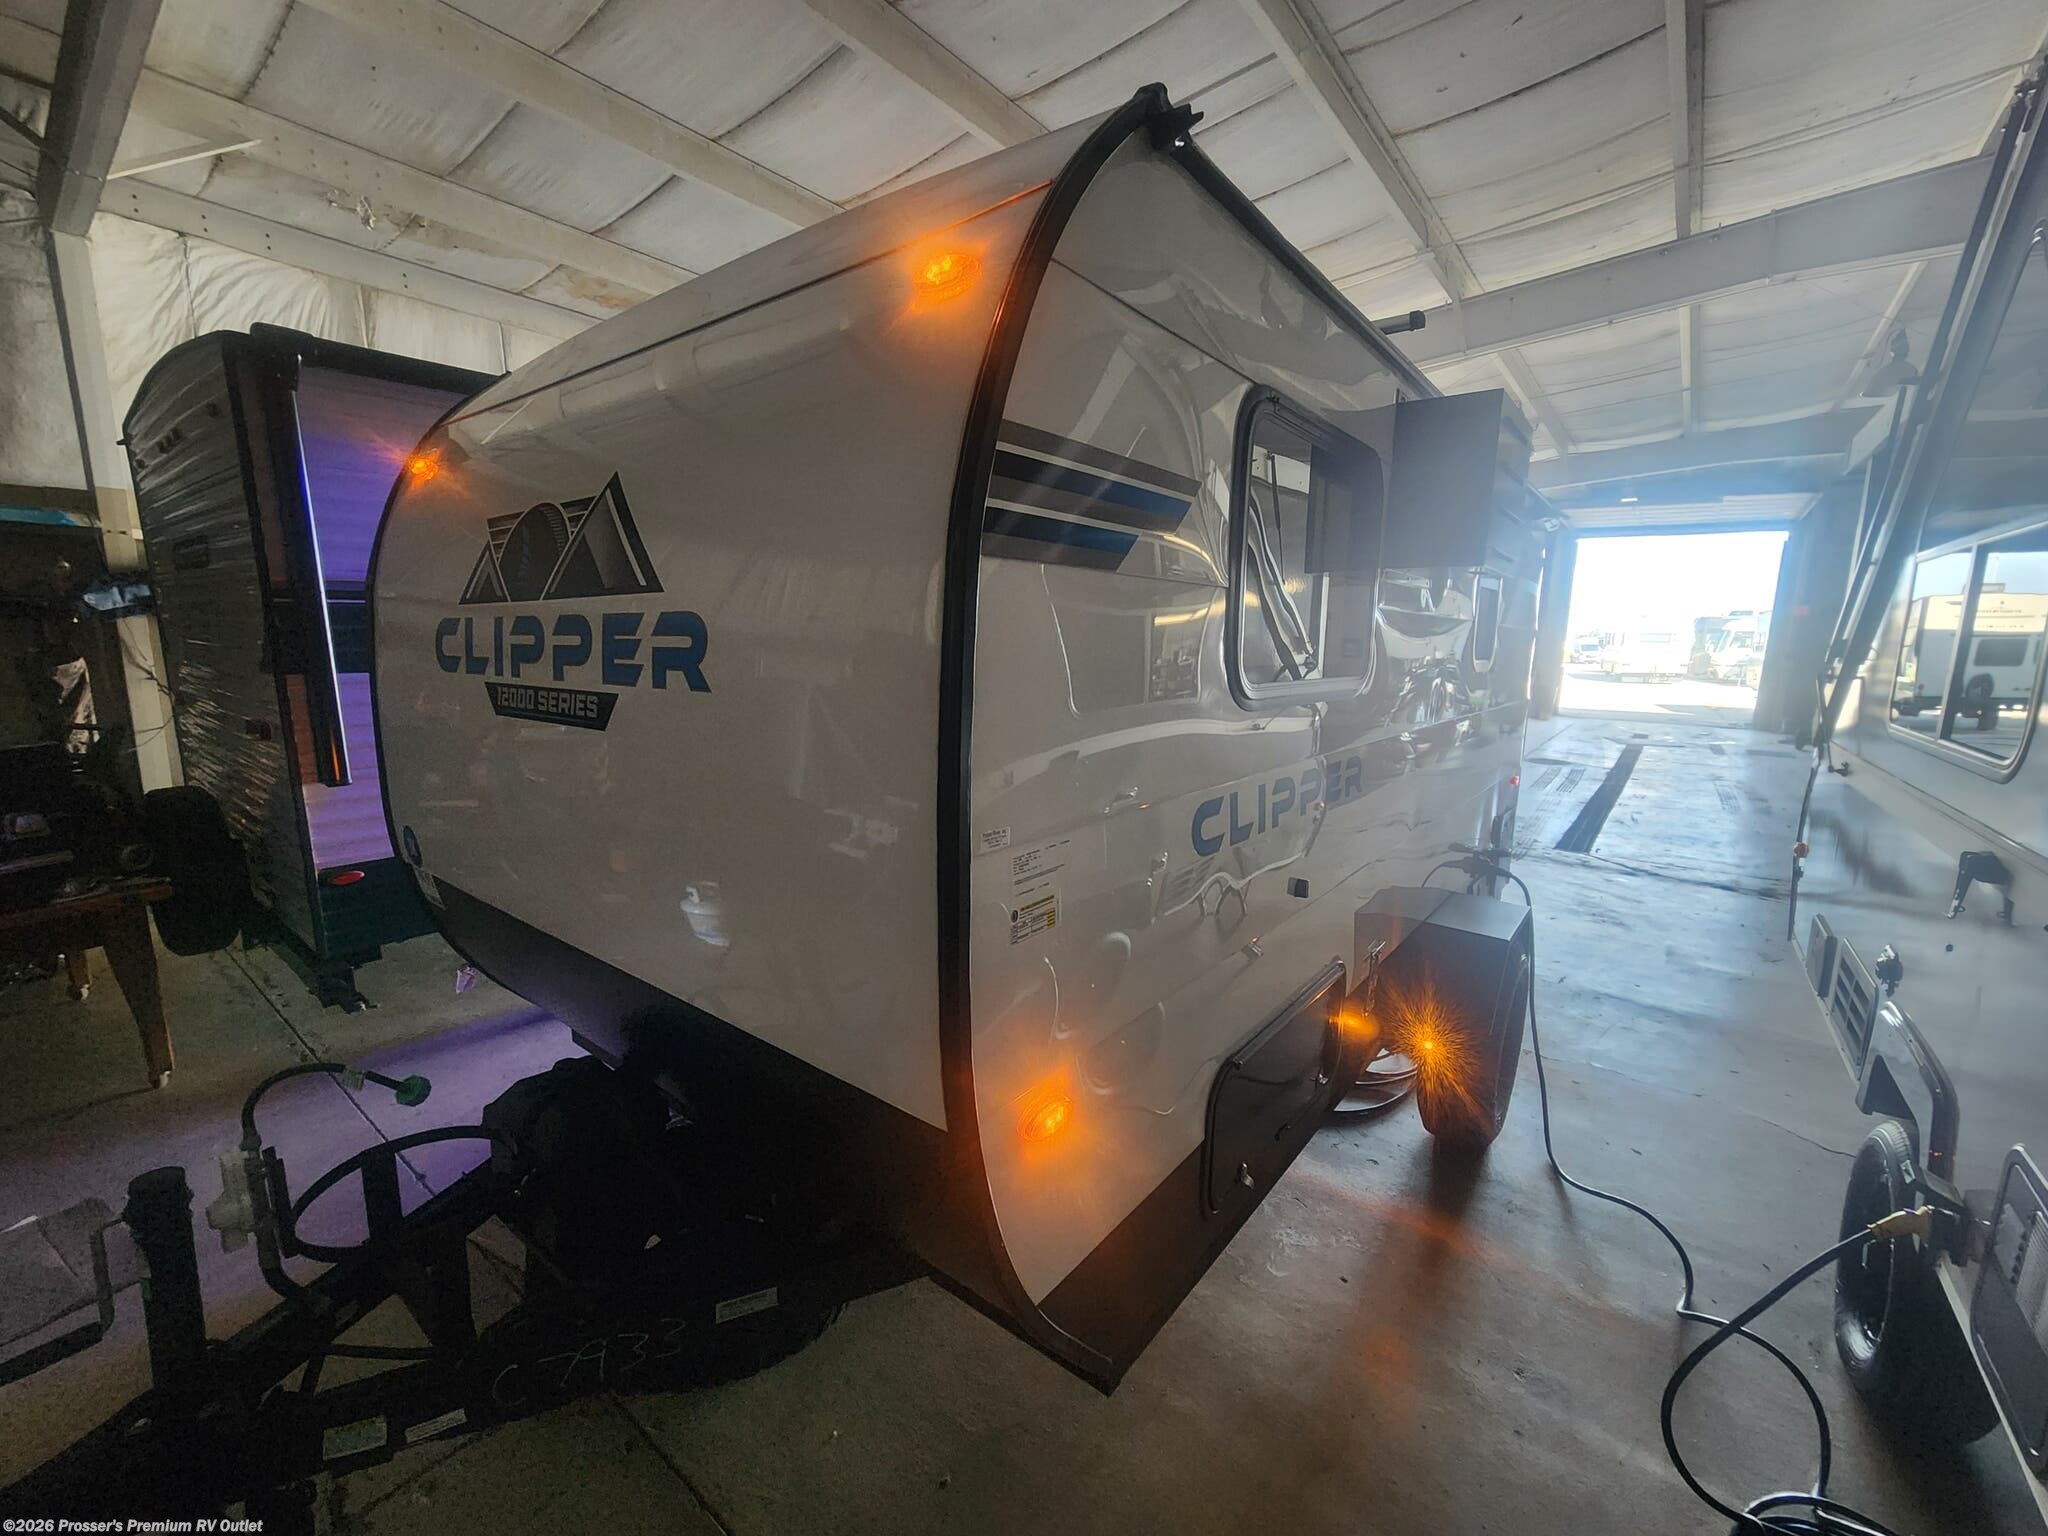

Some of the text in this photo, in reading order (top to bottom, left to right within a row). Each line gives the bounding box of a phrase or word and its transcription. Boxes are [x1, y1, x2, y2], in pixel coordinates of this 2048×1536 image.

[435, 611, 711, 693] CLIPPER
[496, 686, 599, 719] 12000 SERIES
[1191, 755, 1362, 857] CLIPPER
